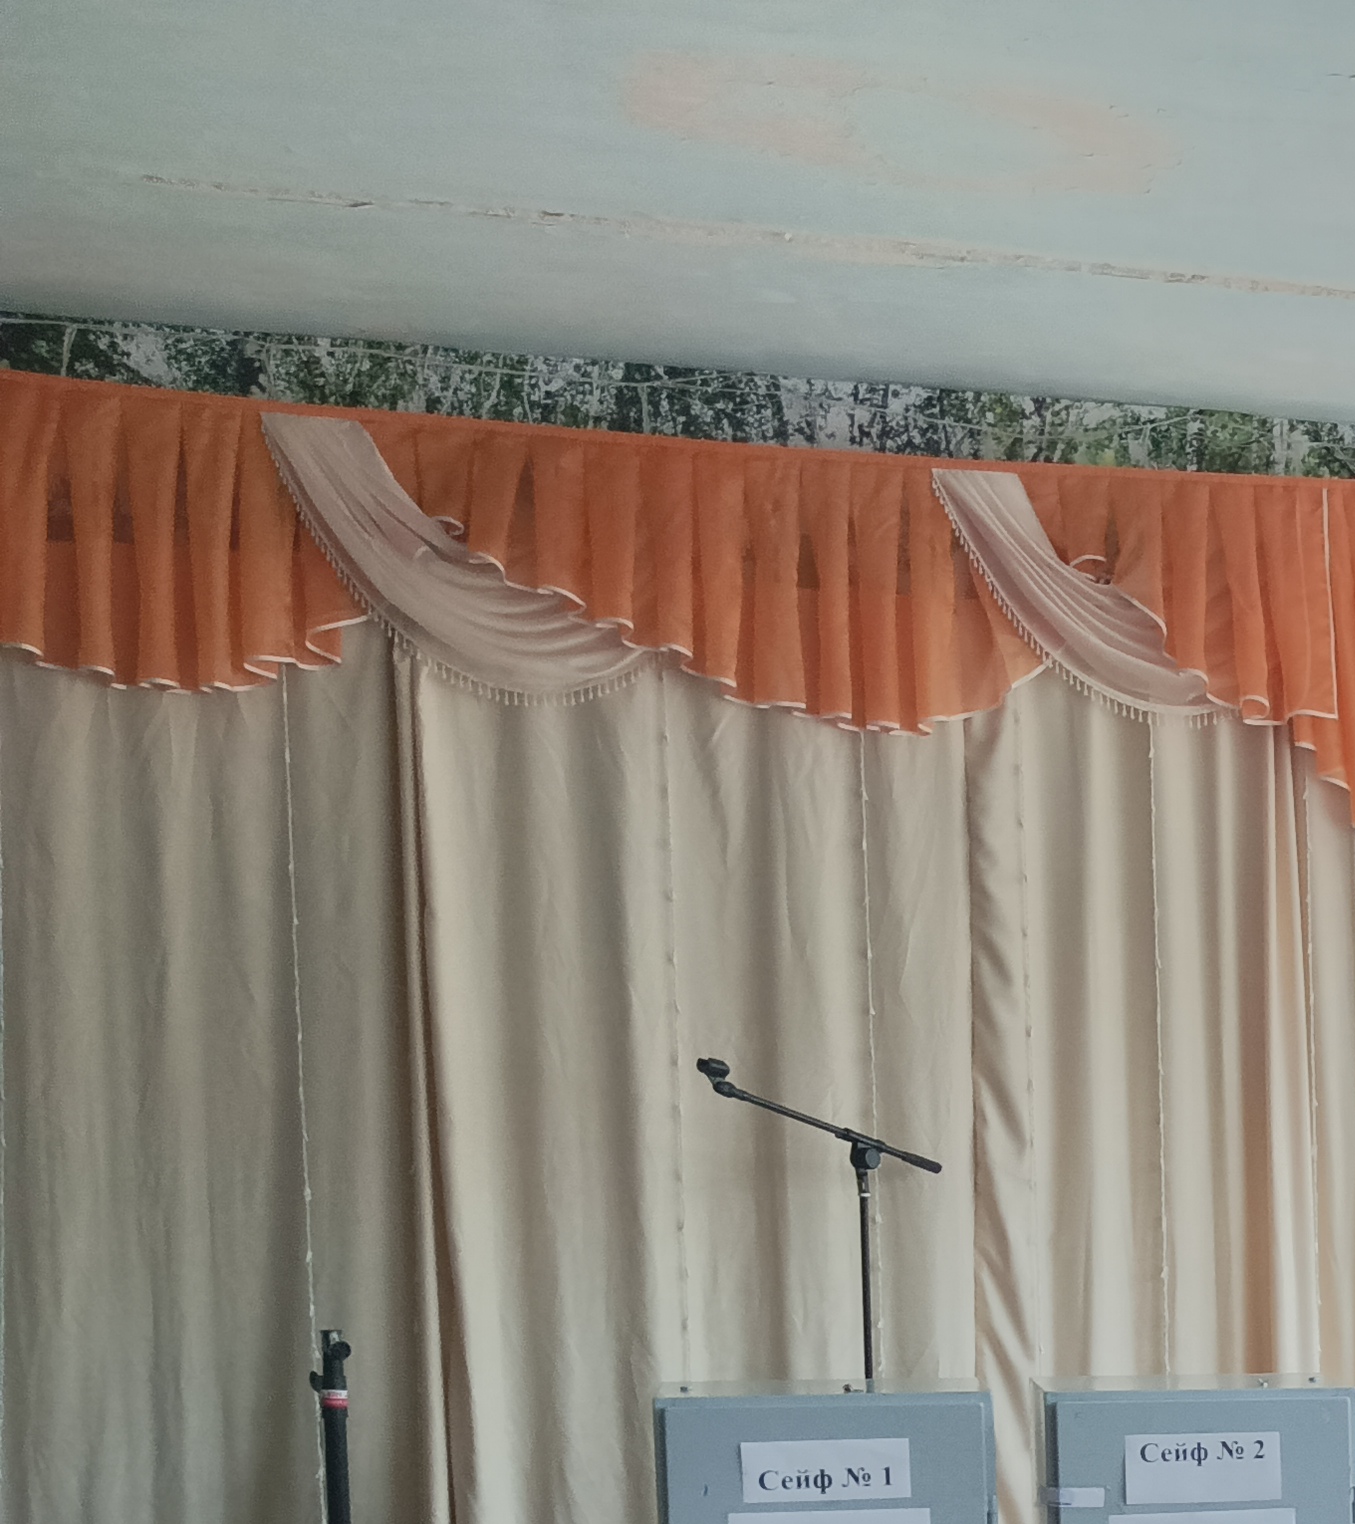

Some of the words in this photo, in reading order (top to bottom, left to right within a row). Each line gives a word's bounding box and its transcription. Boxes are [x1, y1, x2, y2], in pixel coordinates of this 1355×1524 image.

[1140, 1442, 1208, 1466] Сейф
[1217, 1440, 1244, 1460] №
[1253, 1440, 1265, 1459] 2
[758, 1469, 833, 1494] Сейф
[841, 1467, 872, 1488] №
[882, 1466, 893, 1486] 1
